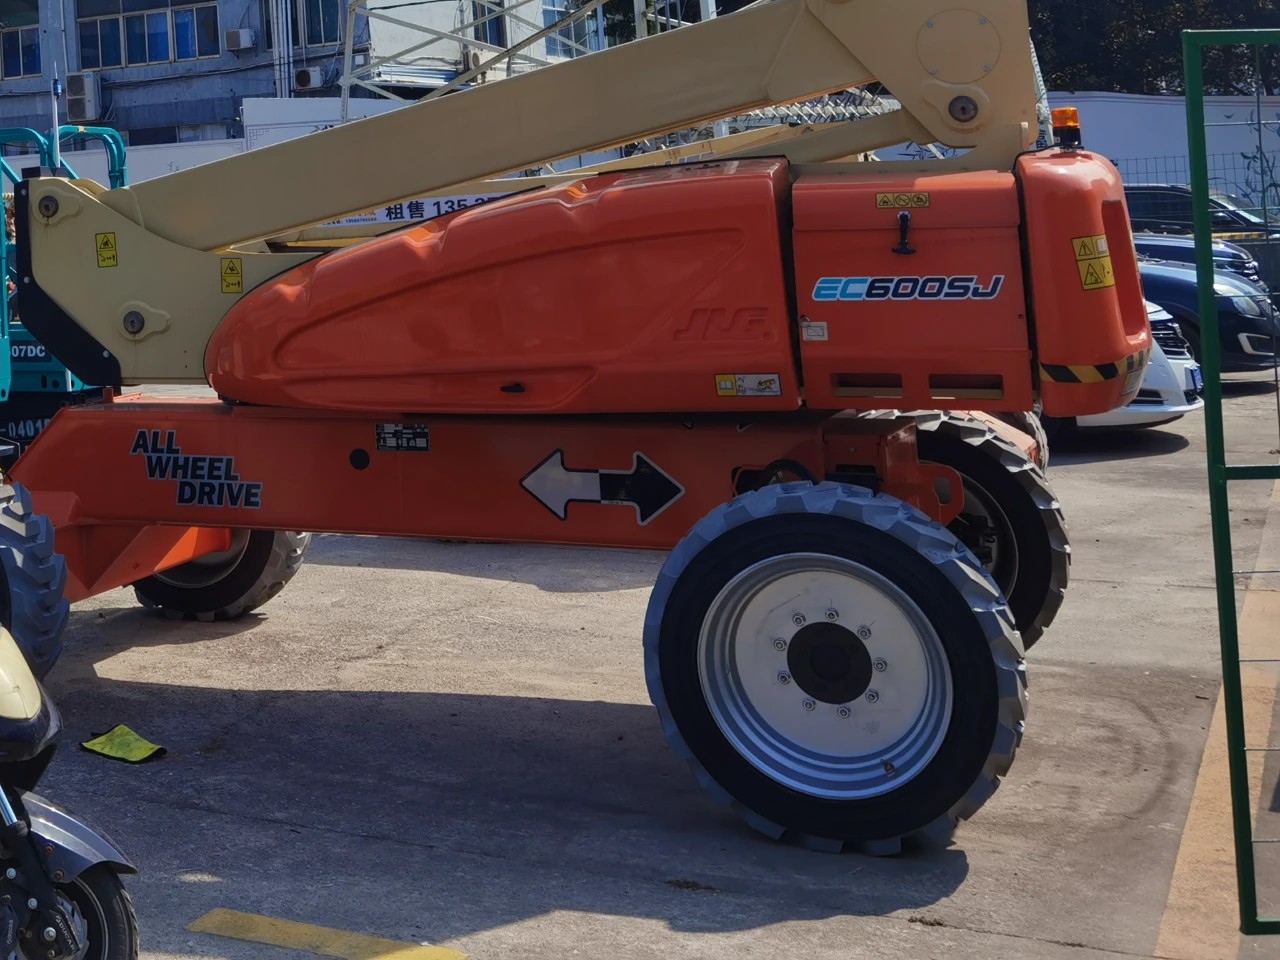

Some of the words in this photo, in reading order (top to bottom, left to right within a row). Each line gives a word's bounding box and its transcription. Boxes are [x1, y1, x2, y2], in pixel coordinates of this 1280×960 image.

[385, 200, 425, 221] 租售
[812, 275, 1005, 301] EC600SJ
[131, 429, 181, 454] ALL
[146, 454, 239, 481] WHEEL
[177, 480, 262, 508] DRIVE
[59, 921, 76, 951] DUCAR
